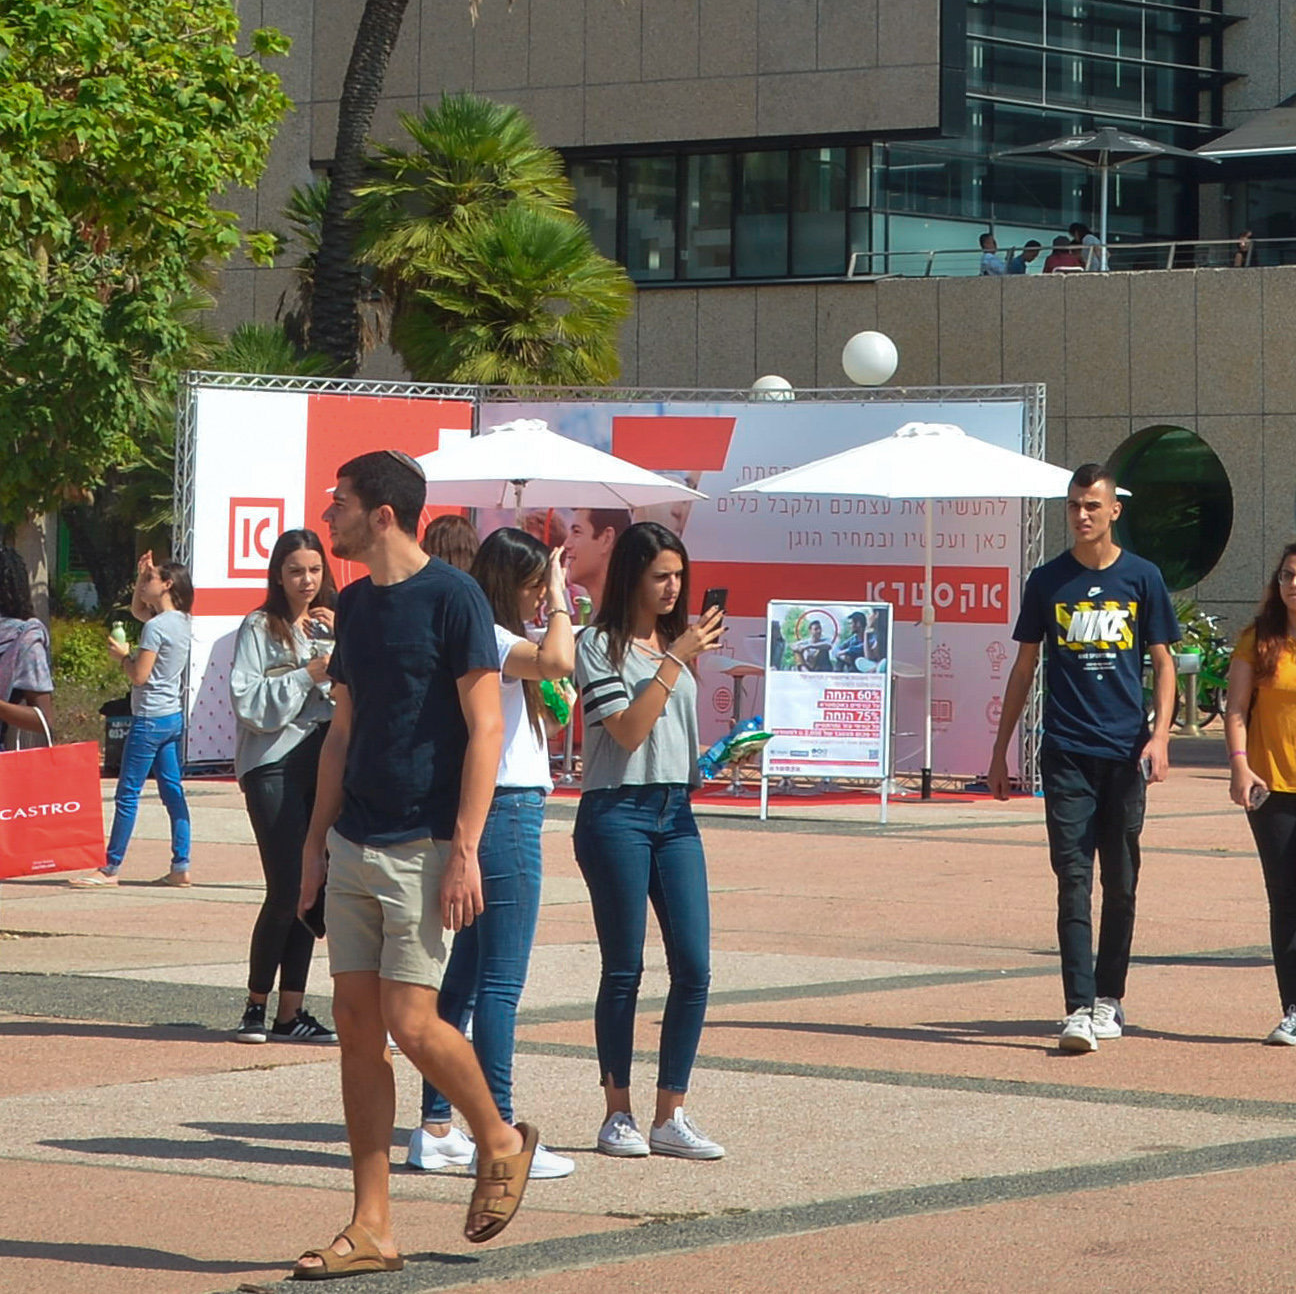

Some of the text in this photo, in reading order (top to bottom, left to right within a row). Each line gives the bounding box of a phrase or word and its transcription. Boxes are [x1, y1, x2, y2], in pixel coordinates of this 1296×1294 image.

[717, 495, 1008, 518] להעשיר את עצמכם ולקבל כלים
[788, 530, 823, 550] הוגן
[831, 531, 894, 548] ובמחיר
[975, 533, 1007, 553] כאן
[1066, 610, 1130, 642] NIKE
[825, 691, 855, 700] הנחה
[825, 711, 854, 720] הנחה
